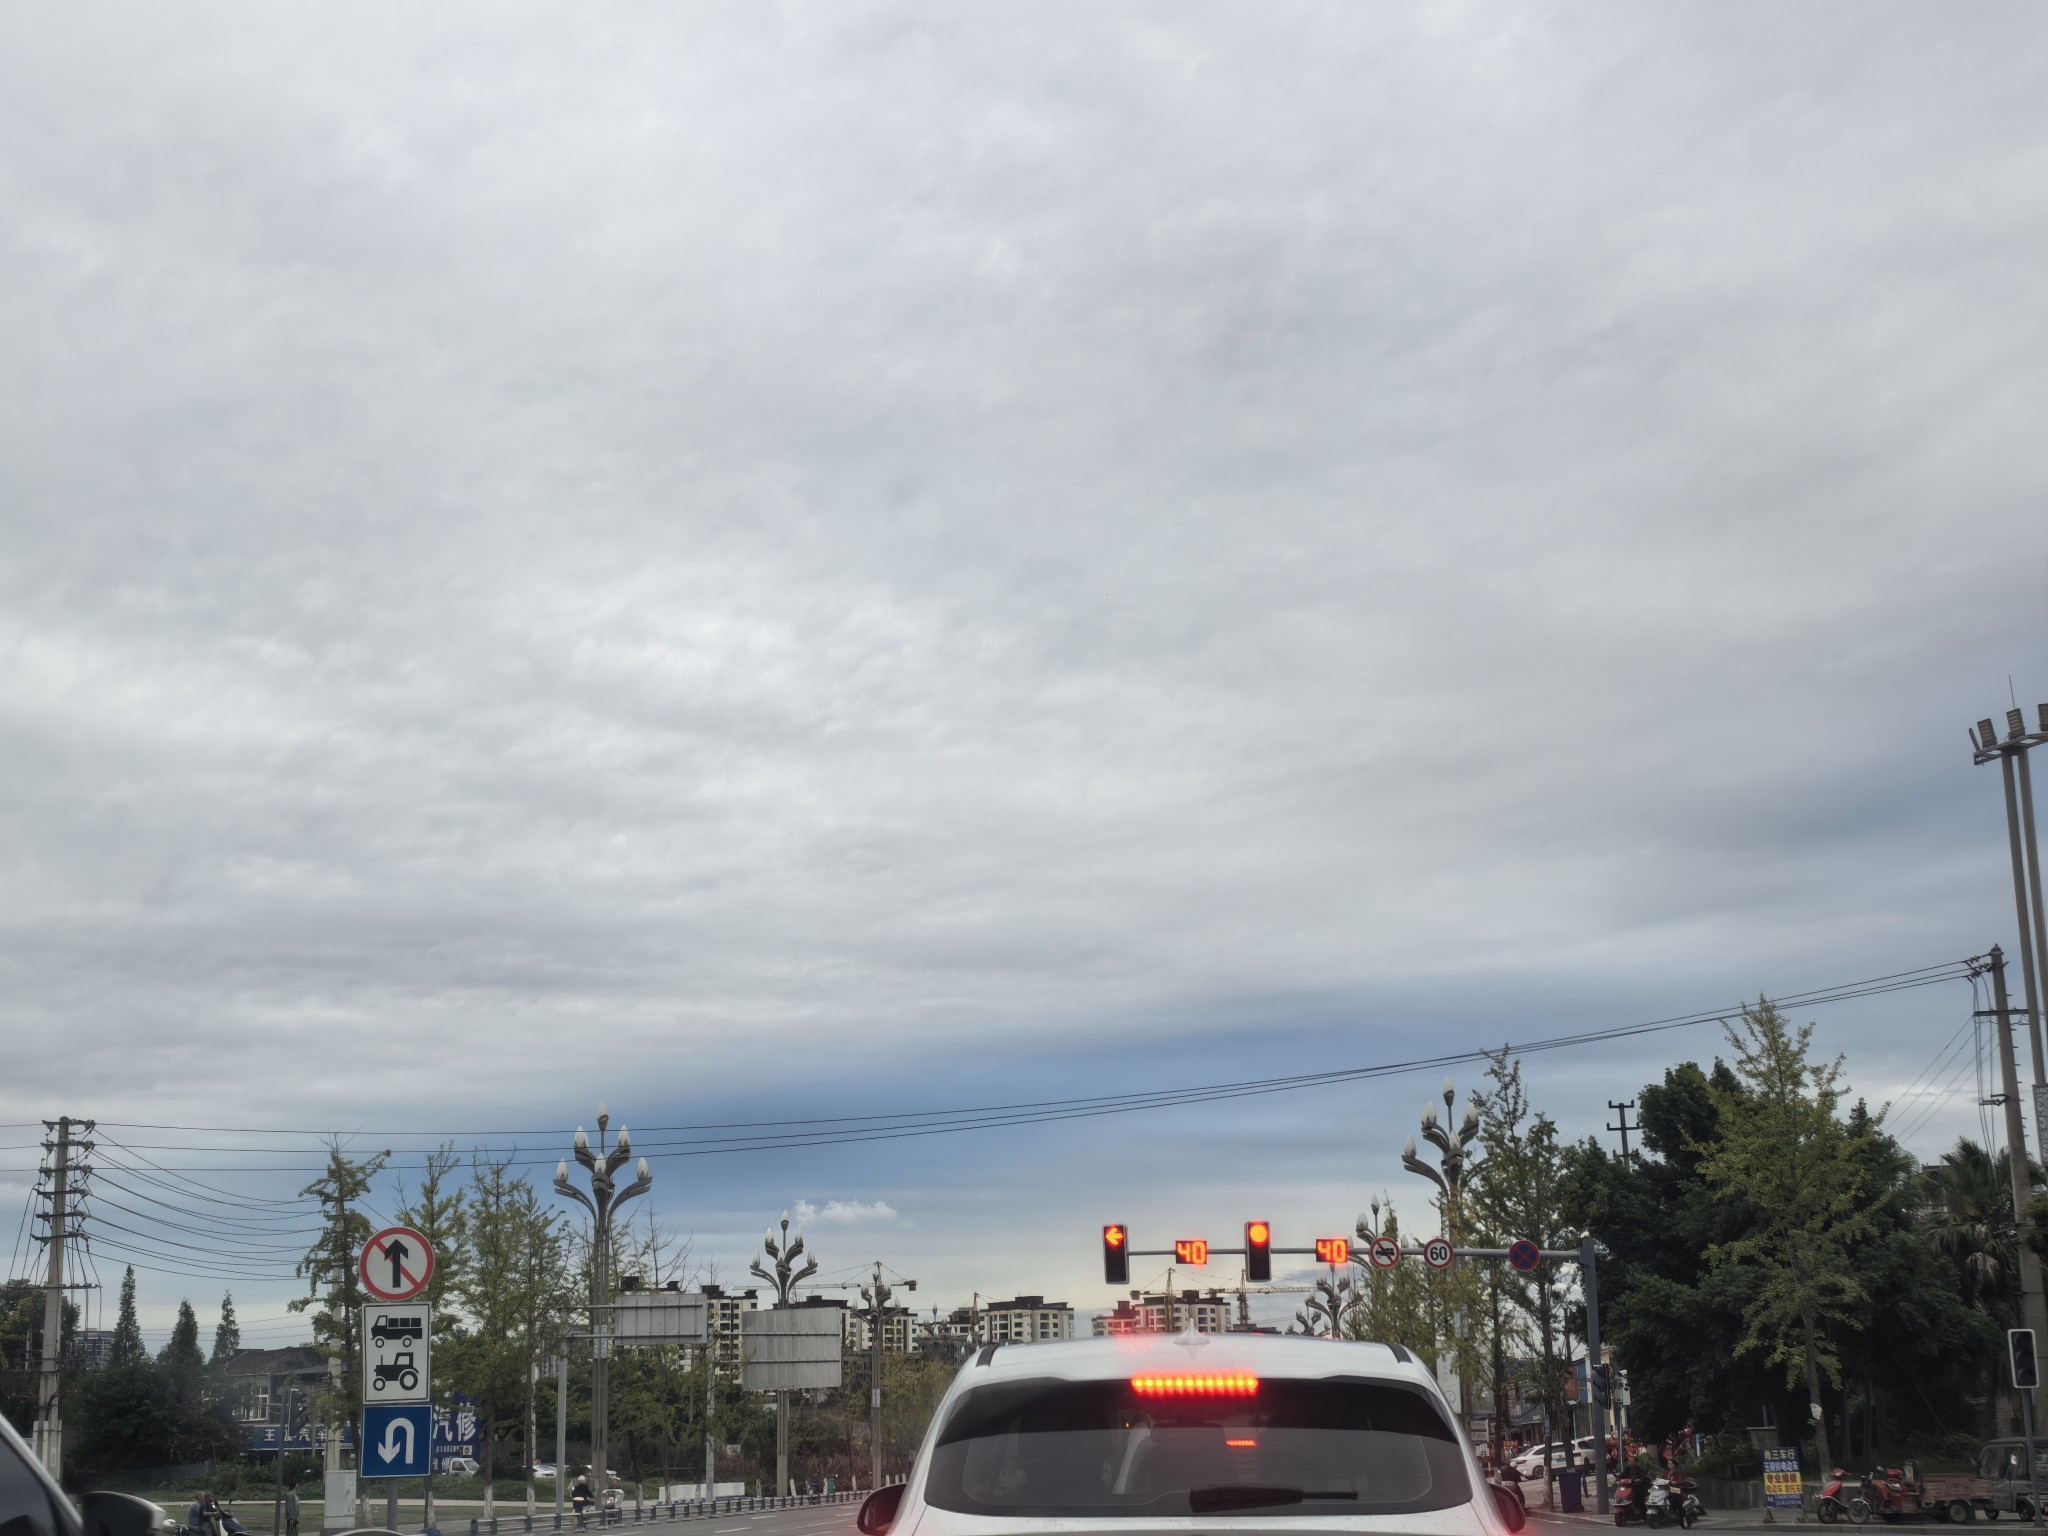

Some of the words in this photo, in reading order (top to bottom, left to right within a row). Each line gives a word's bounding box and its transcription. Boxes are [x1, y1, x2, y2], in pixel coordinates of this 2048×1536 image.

[1177, 1241, 1206, 1264] 40
[1317, 1240, 1346, 1263] 40
[1430, 1246, 1448, 1260] 60
